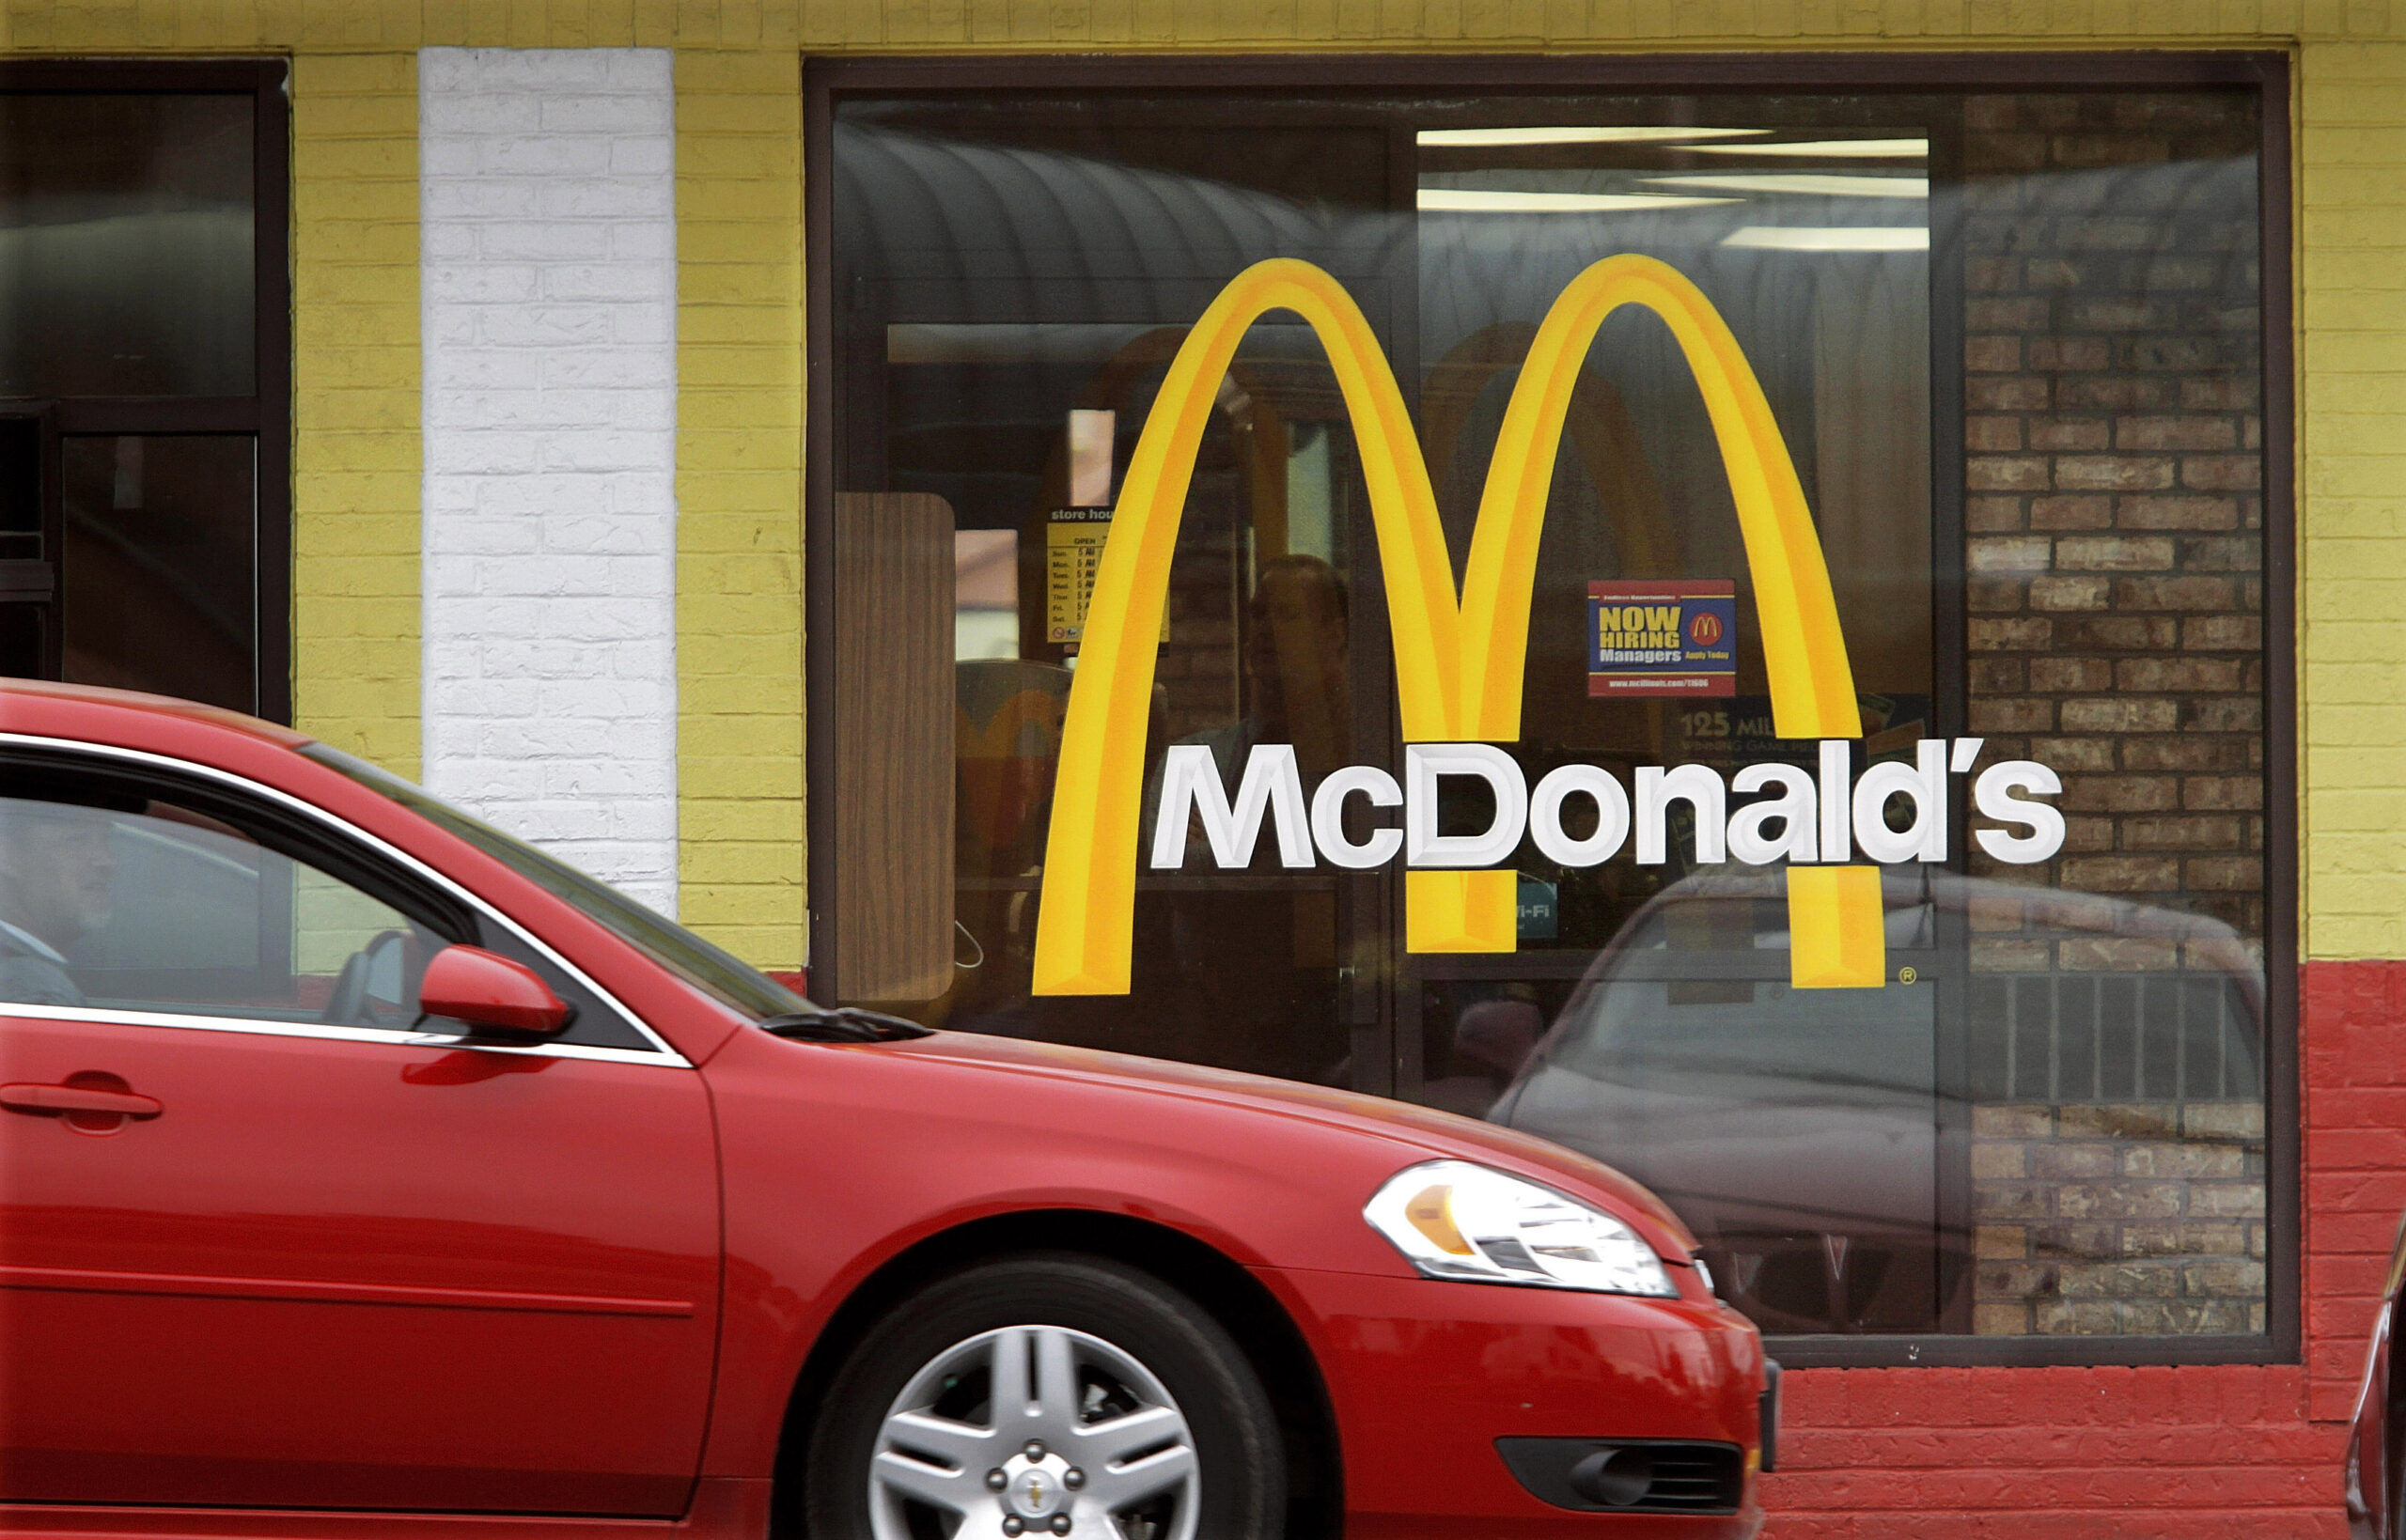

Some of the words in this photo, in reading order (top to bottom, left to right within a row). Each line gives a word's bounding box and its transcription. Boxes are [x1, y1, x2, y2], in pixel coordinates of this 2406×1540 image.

[1052, 509, 1086, 520] store
[1089, 508, 1114, 520] hou
[1599, 606, 1681, 631] NOW
[1600, 631, 1680, 648] HIRING
[1600, 648, 1681, 663] Managers
[1685, 651, 1707, 661] Apply
[1708, 650, 1730, 661] Today
[1680, 710, 1730, 737] 125
[1736, 716, 1775, 737] MIL
[1150, 738, 2066, 869] McDonald's
